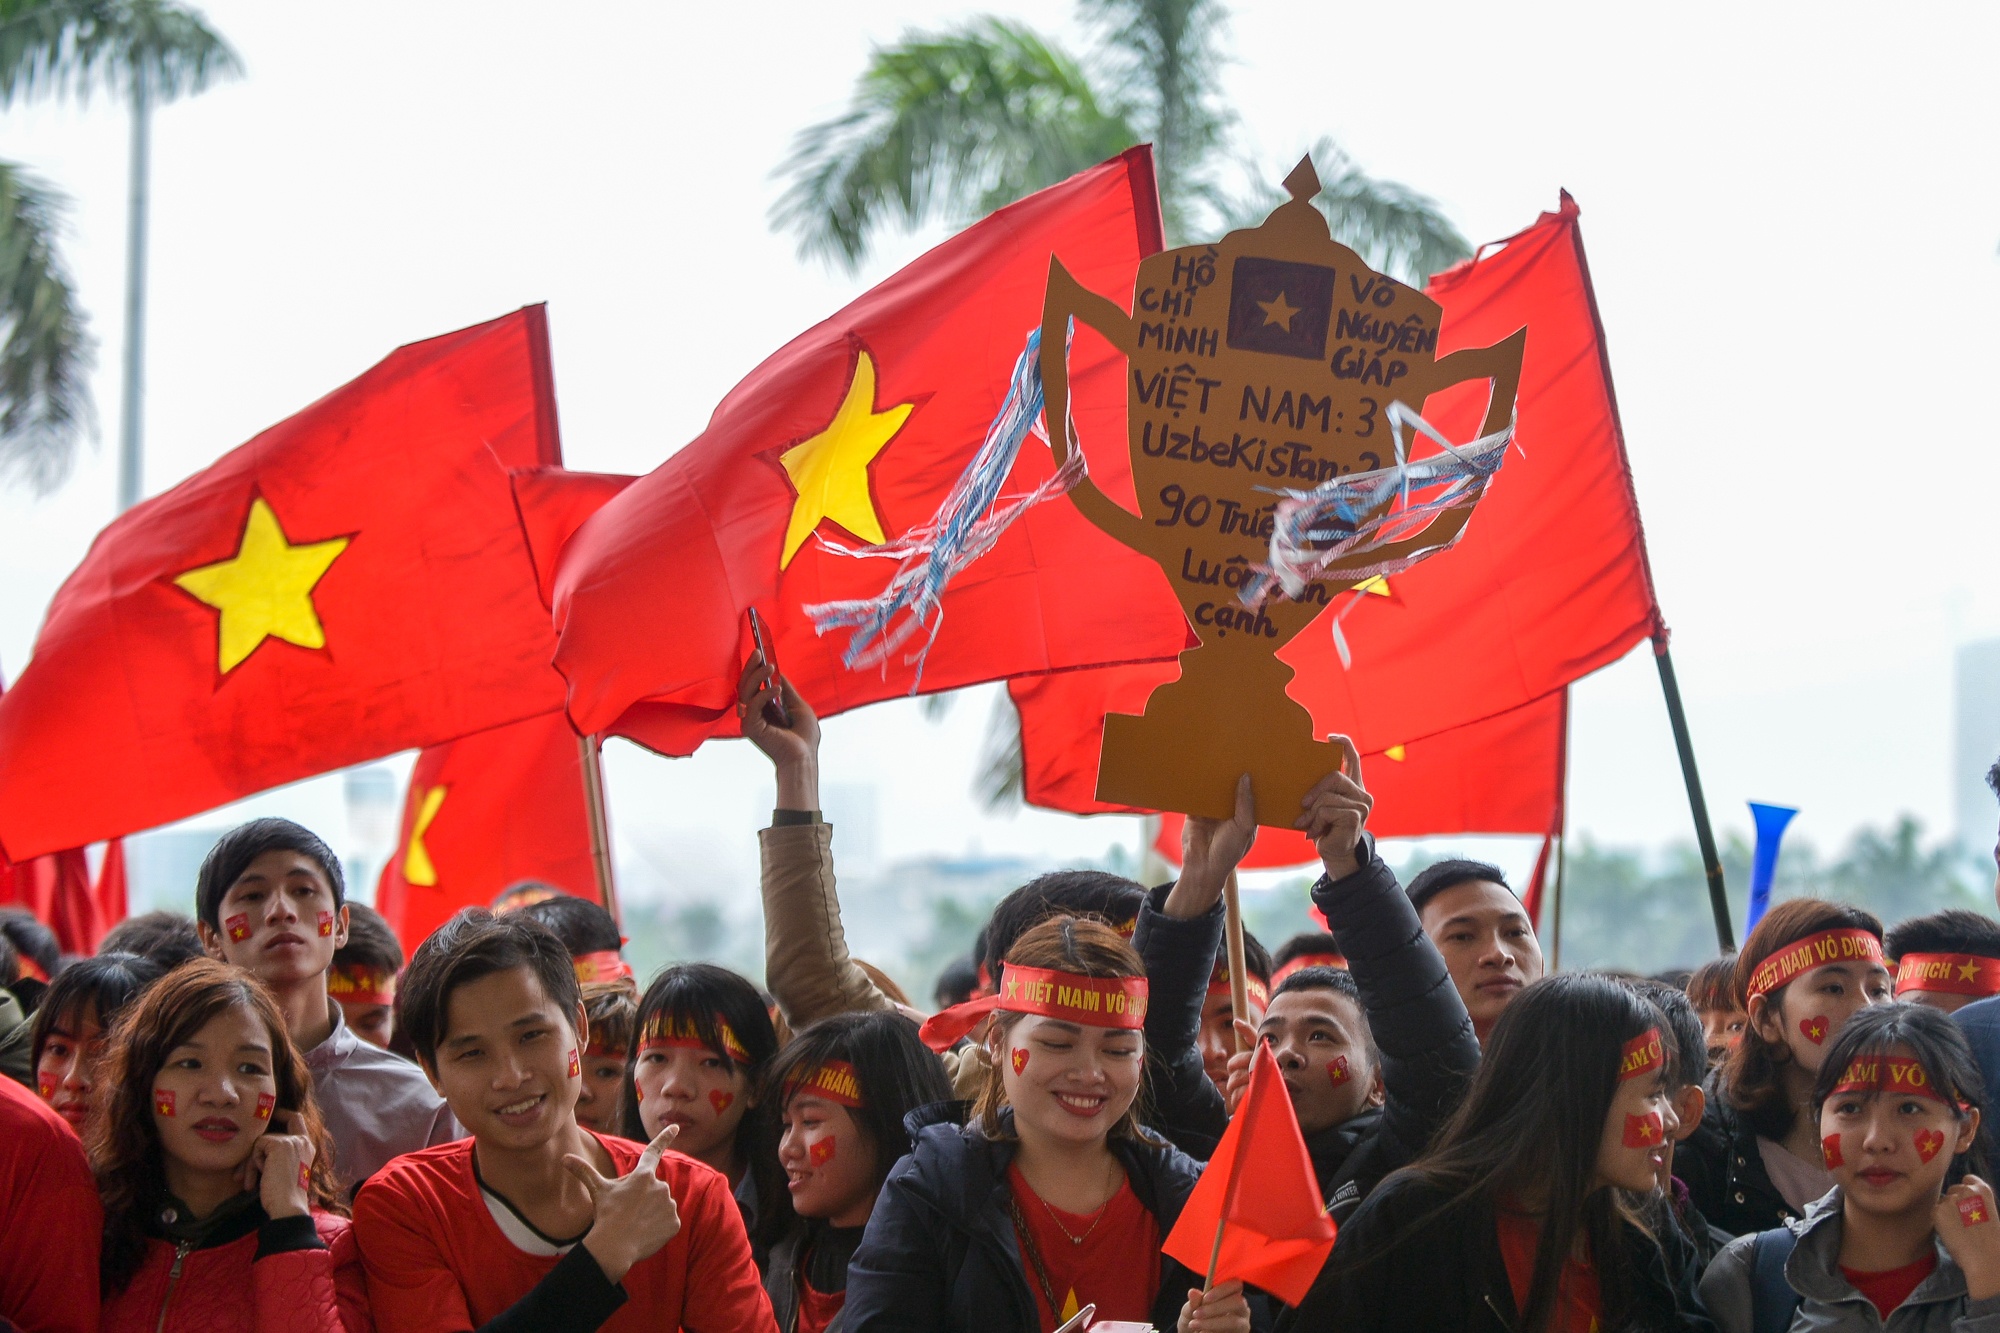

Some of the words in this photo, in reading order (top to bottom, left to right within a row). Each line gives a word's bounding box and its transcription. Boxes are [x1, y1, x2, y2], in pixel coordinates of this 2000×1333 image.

[1355, 397, 1378, 437] 3
[1155, 484, 1211, 527] 90
[1216, 499, 1277, 547] Triệ
[1194, 598, 1279, 638] cạnh
[1780, 945, 1814, 978] NAM
[1814, 934, 1839, 961] VÔ
[1024, 978, 1054, 1007] VIỆT
[1057, 985, 1100, 1012] NAM
[1105, 990, 1126, 1014] VÔ
[1620, 1046, 1650, 1074] AM
[1837, 1062, 1877, 1086] AM
[1889, 1062, 1926, 1087] VÔ
